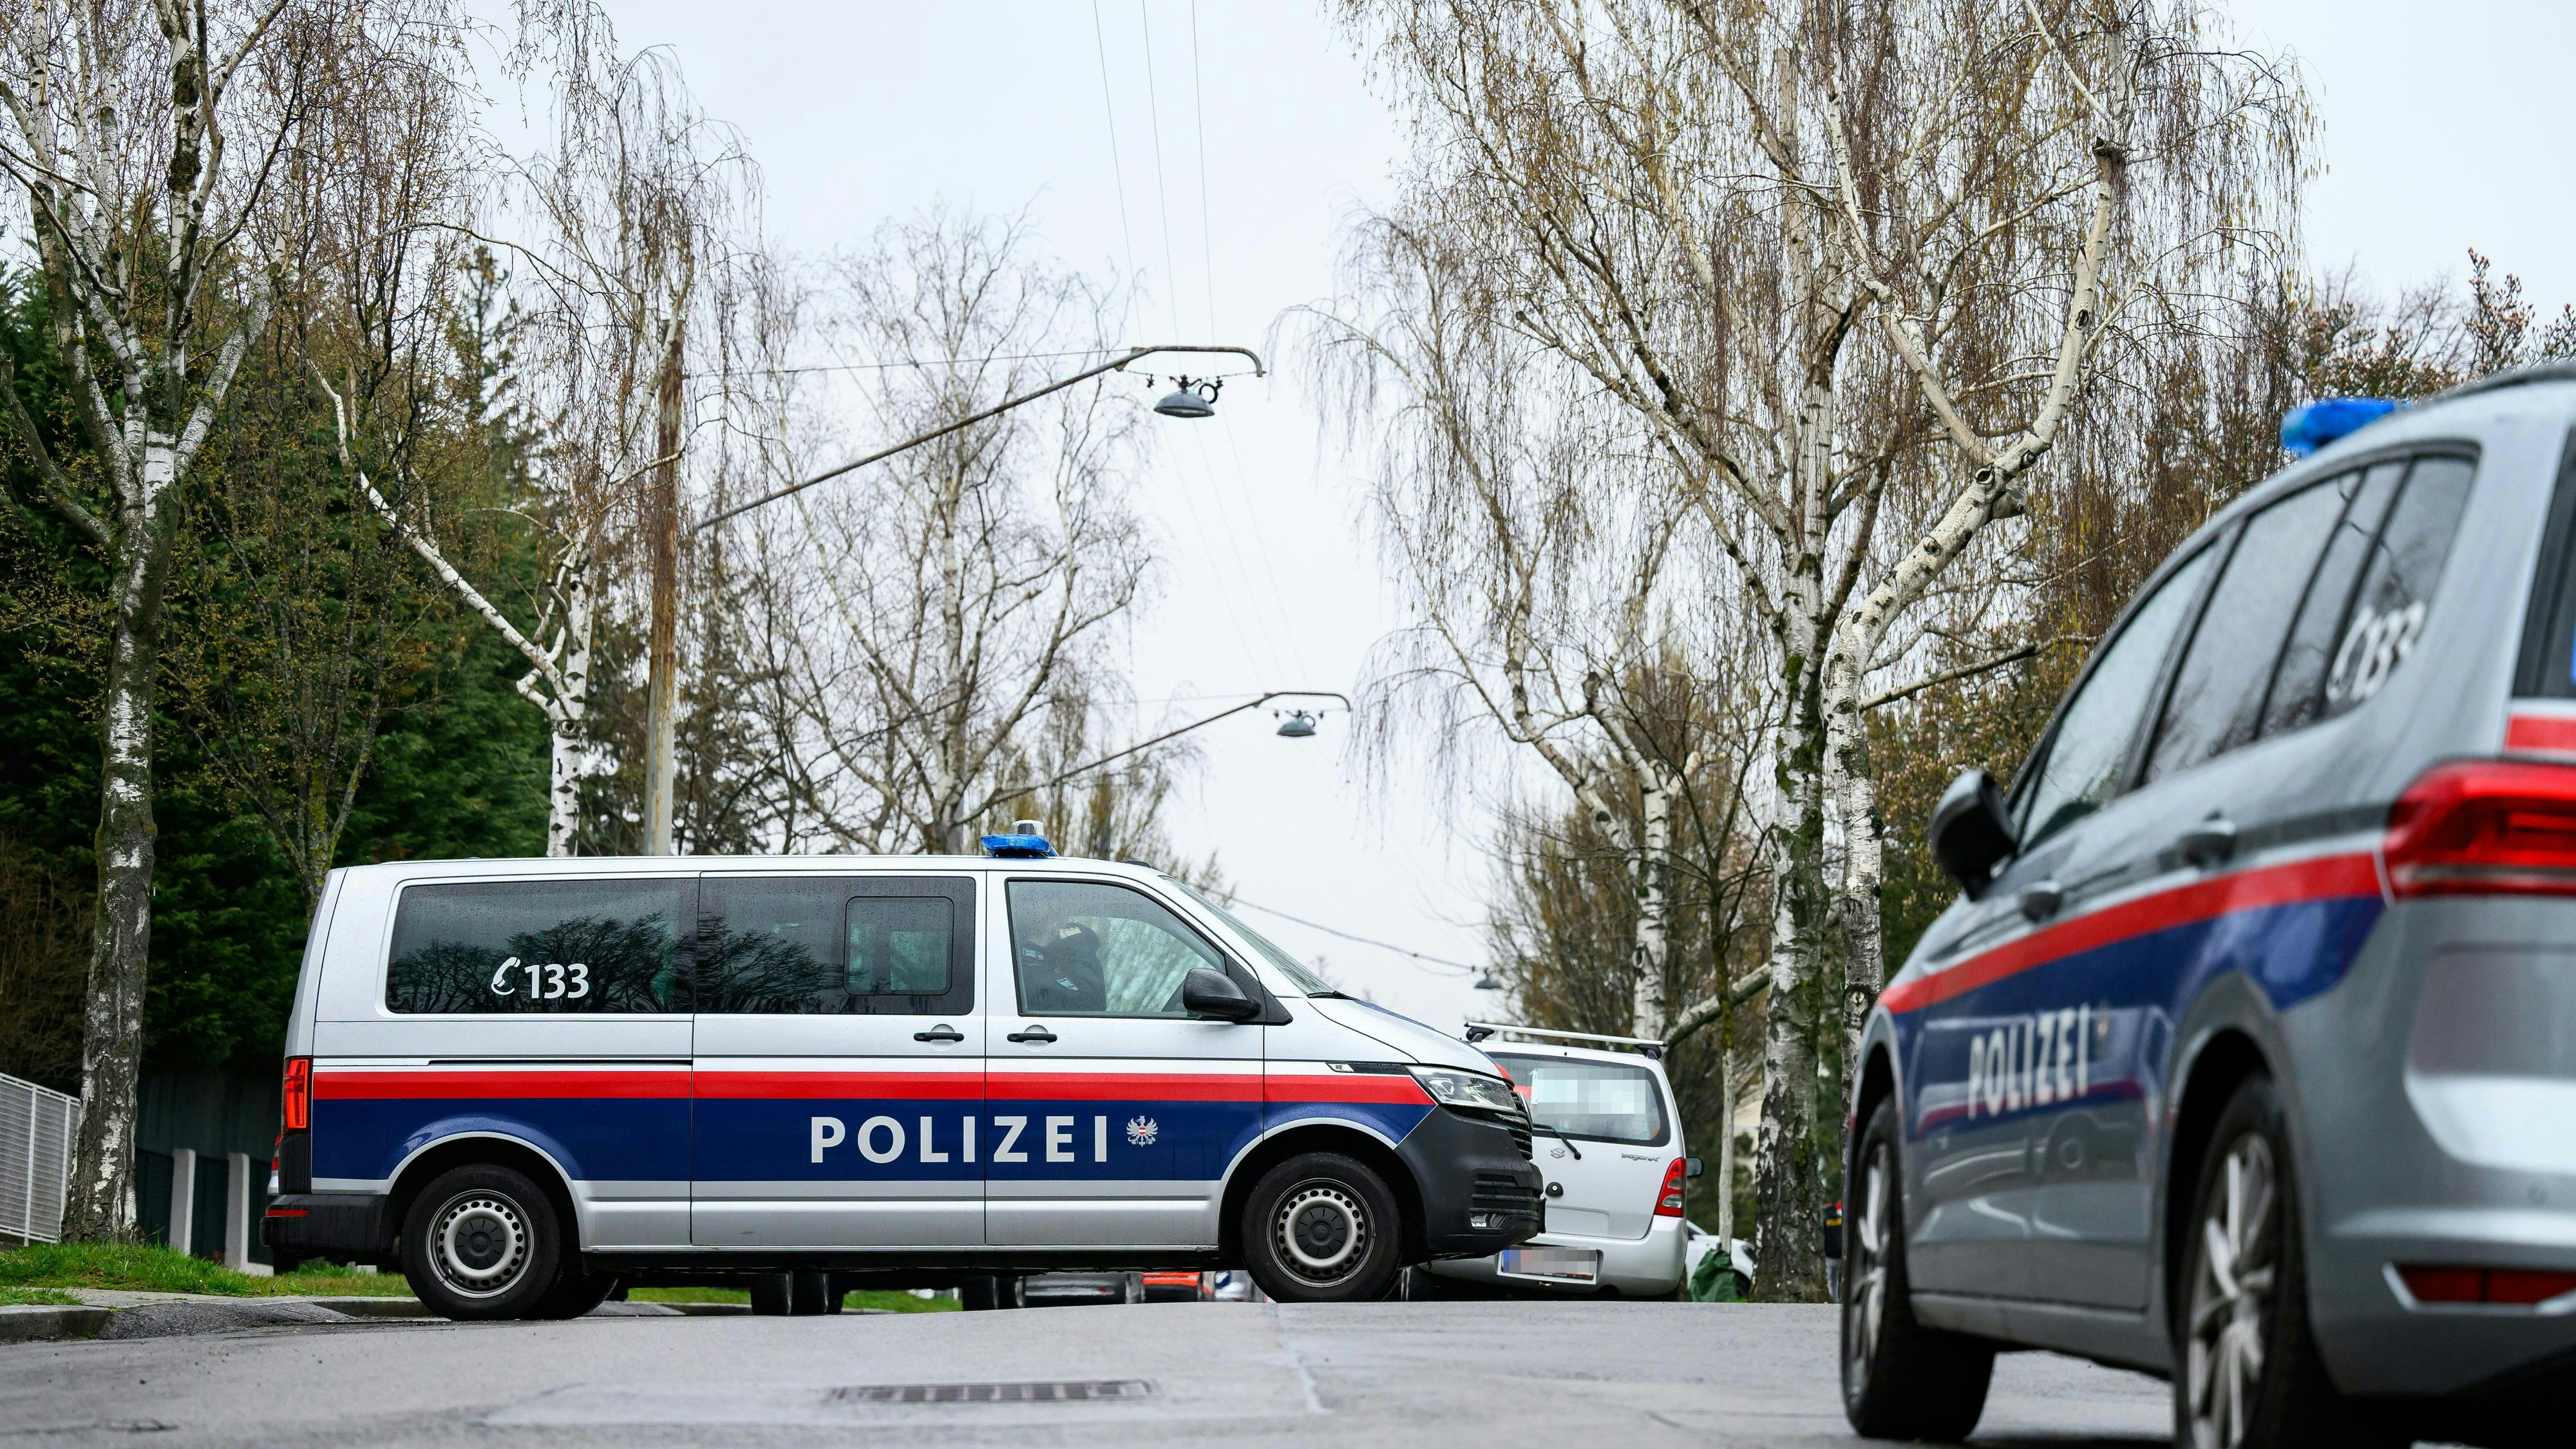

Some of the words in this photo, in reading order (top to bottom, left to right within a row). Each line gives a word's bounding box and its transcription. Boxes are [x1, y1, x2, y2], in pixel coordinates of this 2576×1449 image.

[524, 963, 589, 998] 133
[1967, 1002, 2090, 1121] POLIZEI
[811, 1115, 1107, 1164] POLIZEI
